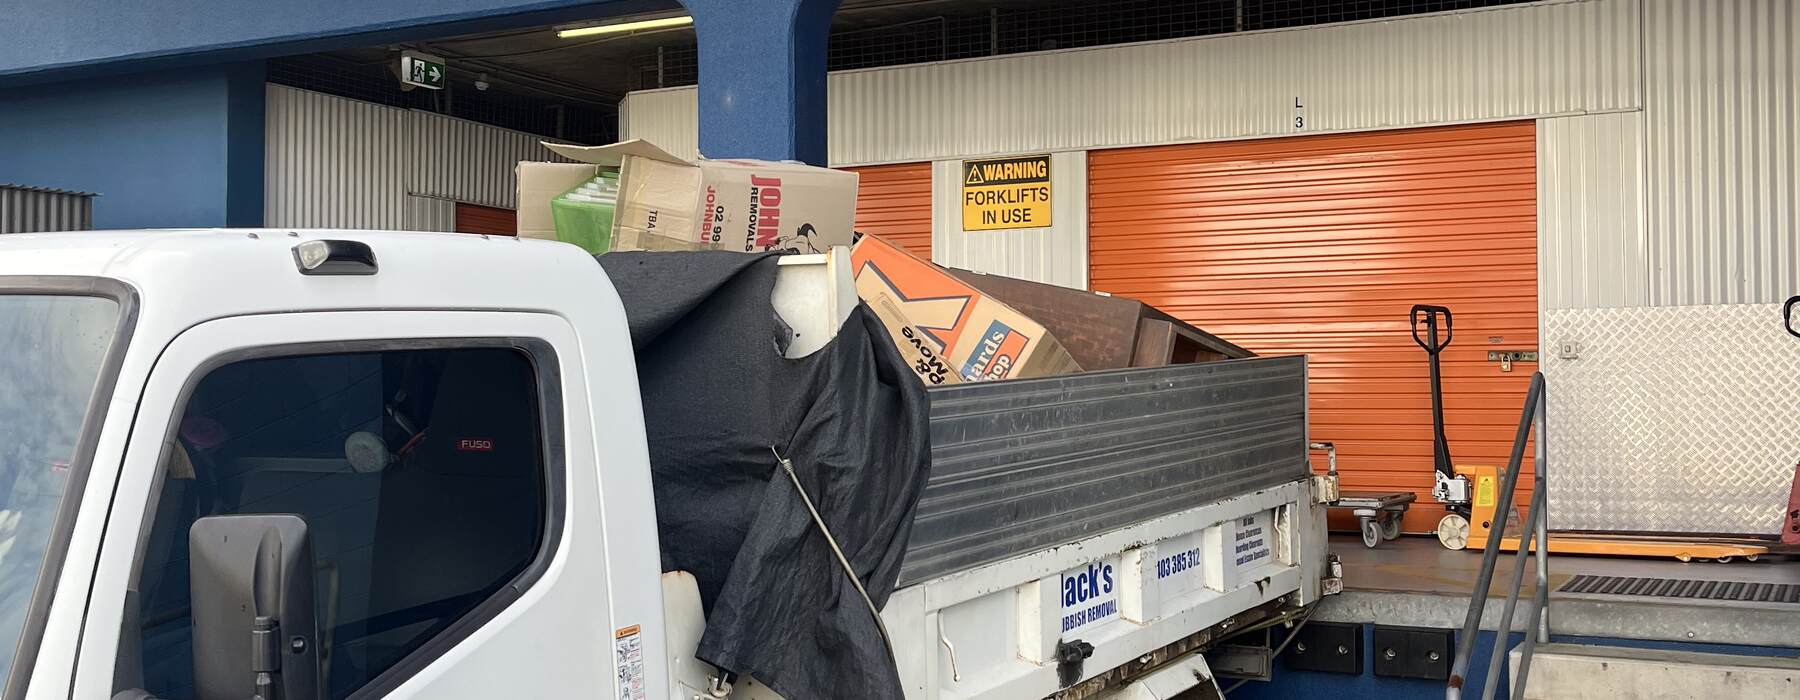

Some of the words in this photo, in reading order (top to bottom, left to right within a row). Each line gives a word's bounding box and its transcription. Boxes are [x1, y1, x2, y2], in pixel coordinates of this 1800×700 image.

[1295, 97, 1303, 108] L
[1295, 116, 1303, 128] 3
[983, 160, 1047, 181] WARNING
[966, 187, 1049, 206] FORKLIFTS
[647, 210, 658, 229] TBA
[714, 205, 725, 223] 02
[745, 187, 759, 252] REMOVALS
[750, 174, 781, 247] JOHN
[982, 209, 997, 225] IN
[1002, 207, 1032, 224] USE
[901, 326, 949, 375] Move
[1172, 553, 1187, 574] 385
[1187, 547, 1200, 568] 312
[1088, 599, 1117, 623] REMOVAL
